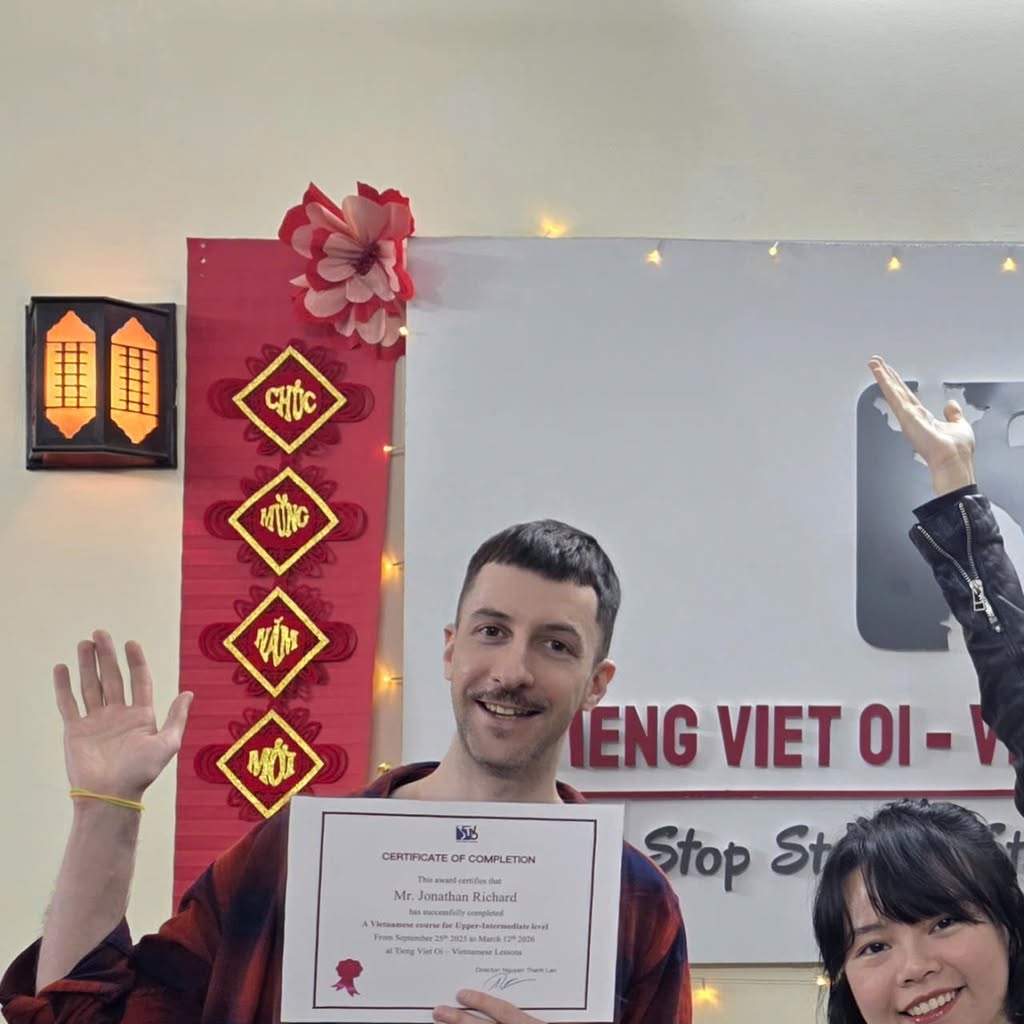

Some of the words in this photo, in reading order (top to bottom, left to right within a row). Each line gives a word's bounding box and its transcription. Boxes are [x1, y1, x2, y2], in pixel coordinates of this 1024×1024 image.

[265, 379, 317, 422] CHÚC
[254, 616, 299, 667] NĂM
[569, 704, 698, 768] IENG
[717, 705, 842, 768] VIET
[859, 703, 911, 767] OI
[247, 737, 297, 787] MỚI
[382, 852, 448, 863] CERTIFICATE
[451, 854, 466, 863] OF
[468, 854, 536, 864] COMPLETION
[644, 825, 751, 892] Stop
[434, 876, 457, 884] award
[393, 890, 414, 901] Mr.
[418, 890, 469, 902] Jonathan
[473, 891, 517, 903] Richard
[467, 909, 504, 919] completed
[370, 920, 414, 929] Vietnamese
[442, 921, 453, 929] for
[455, 921, 530, 931] Upper-Intermediate
[531, 923, 549, 931] level
[374, 933, 394, 941] From
[395, 933, 434, 943] September
[478, 935, 501, 943] March
[451, 947, 493, 957] Vietnamese
[494, 948, 523, 957] Lessons
